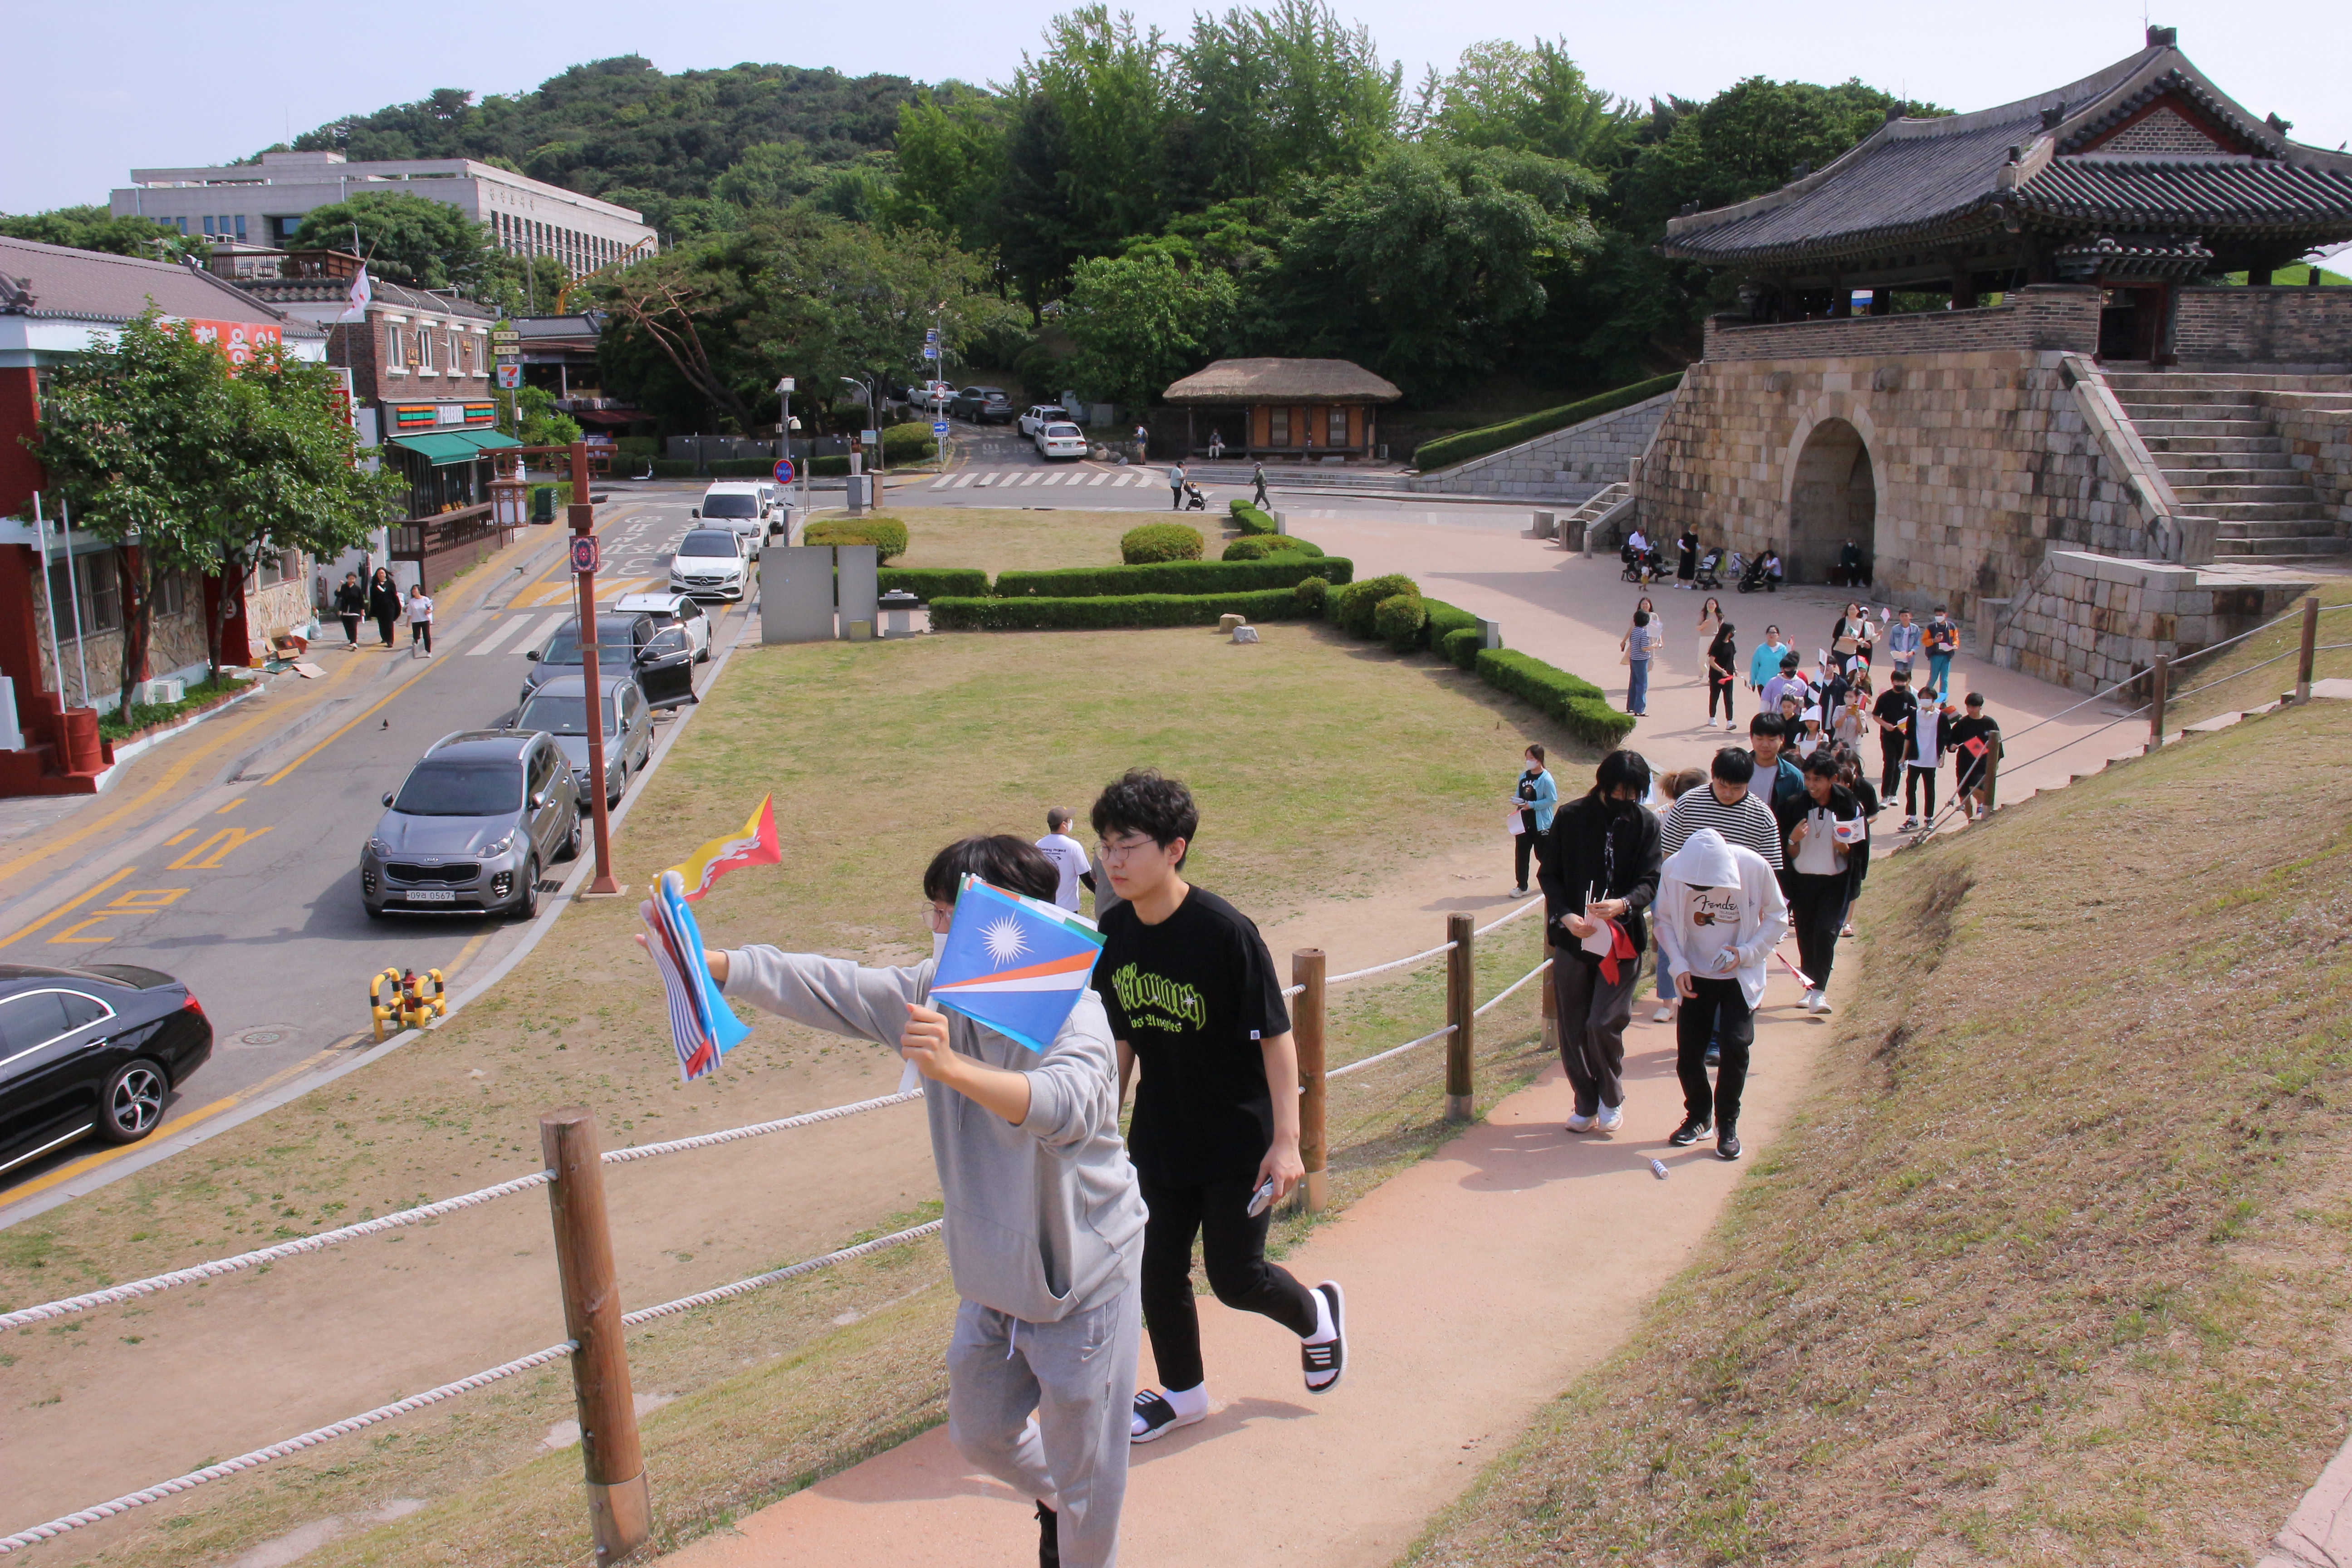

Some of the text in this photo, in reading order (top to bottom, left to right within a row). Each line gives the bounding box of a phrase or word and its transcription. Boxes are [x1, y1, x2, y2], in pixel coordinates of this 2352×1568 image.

[501, 366, 517, 387] 7
[1522, 780, 1535, 789] COAC
[1693, 895, 1738, 911] Fende
[1145, 1014, 1182, 1033] Angeles
